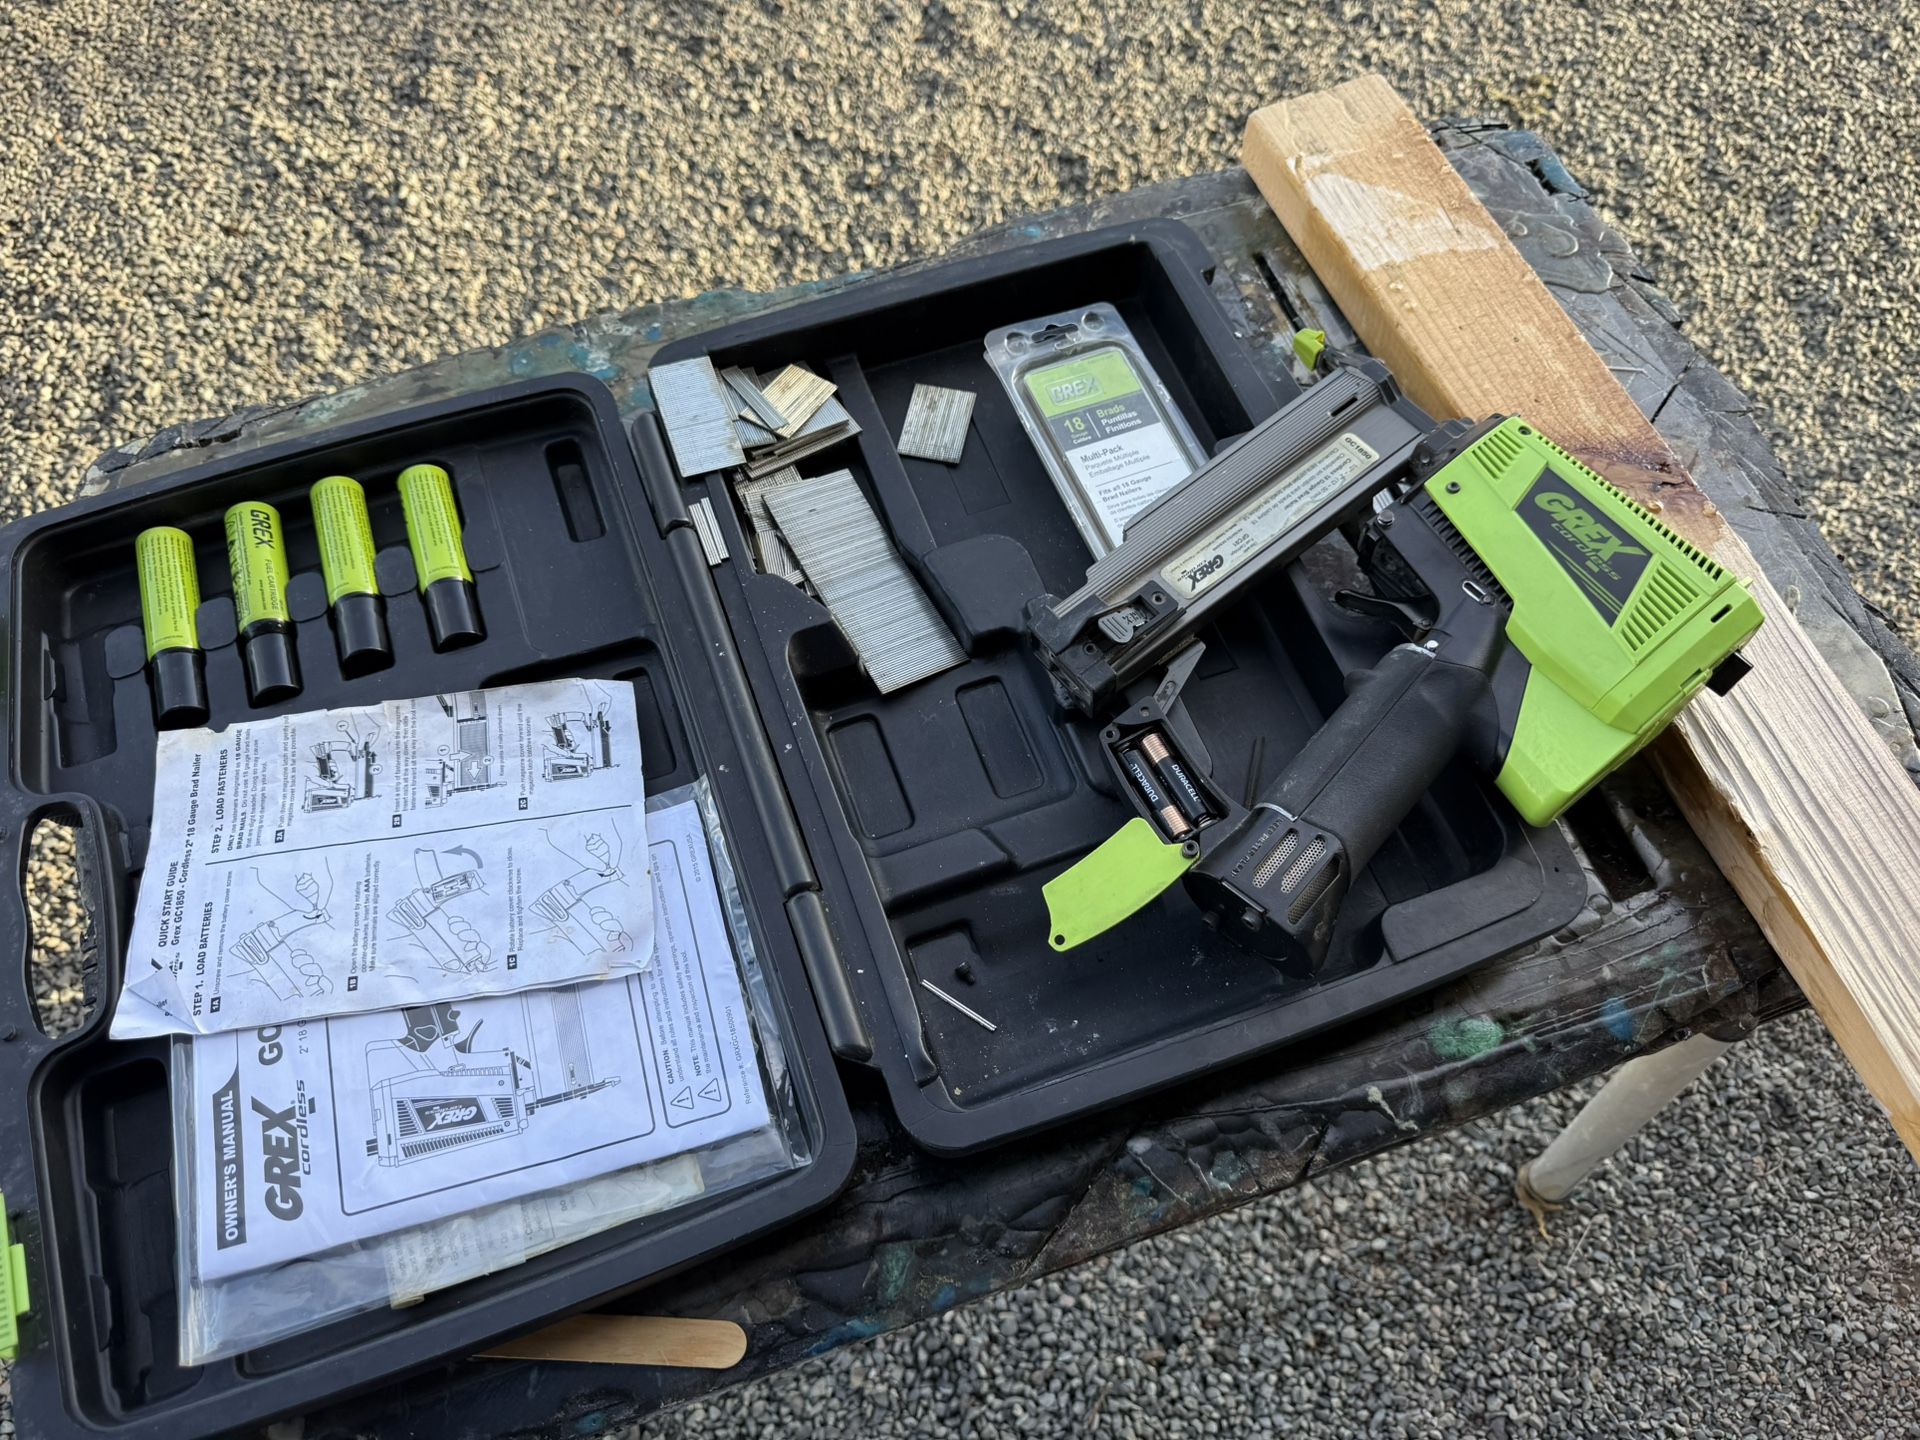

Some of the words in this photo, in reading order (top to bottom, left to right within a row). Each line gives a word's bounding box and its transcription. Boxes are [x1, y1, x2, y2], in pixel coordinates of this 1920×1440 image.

[1096, 404, 1125, 417] Brads
[1101, 411, 1137, 425] Puntillas
[1064, 417, 1085, 432] 18
[1105, 419, 1142, 434] Finitions
[1080, 444, 1123, 463] Multi-Pack
[250, 509, 275, 549] GREX
[1534, 492, 1648, 562] GREX
[1551, 523, 1622, 581] cordless
[1188, 555, 1224, 592] GREX
[191, 753, 201, 777] Nailer
[216, 748, 229, 796] FASTENERS
[189, 778, 199, 797] Brad
[1131, 763, 1159, 803] DURACELL
[1171, 764, 1200, 802] DURACELL
[187, 799, 199, 825] Gauge
[214, 797, 225, 820] LOAD
[519, 798, 526, 809] 2C
[186, 827, 195, 836] 18
[214, 823, 222, 831] 2.
[275, 830, 284, 842] 2A
[211, 833, 221, 853] STEP
[165, 860, 178, 886] GUIDE
[178, 849, 192, 882] Cordless
[162, 888, 173, 916] START
[173, 889, 185, 923] GC1850
[221, 903, 230, 922] battery
[158, 917, 170, 947] QUICK
[170, 924, 181, 945] Grex
[198, 901, 213, 949] BATTERIES
[217, 933, 225, 954] remove
[196, 950, 207, 975] LOAD
[508, 955, 516, 968] 1C
[194, 980, 203, 988] 1.
[213, 968, 221, 994] Unscrew
[658, 977, 670, 1009] instructions
[192, 991, 203, 1016] STEP
[210, 997, 220, 1011] 1A
[652, 991, 663, 1022] attempting
[687, 980, 699, 1010] inspection
[693, 1011, 701, 1023] and
[298, 1030, 307, 1041] 18
[657, 1023, 667, 1045] Before
[668, 1023, 676, 1038] rules
[696, 1023, 709, 1062] maintenance
[724, 1005, 741, 1061] GRXGC18500901
[662, 1047, 674, 1084] CAUTION:
[673, 1048, 684, 1081] understand
[740, 1071, 752, 1104] Reference
[221, 1090, 237, 1160] MANUAL
[297, 1079, 311, 1175] cordless
[426, 1106, 477, 1130] GREX
[251, 1096, 304, 1221] GREX
[223, 1165, 238, 1240] OWNER'S
